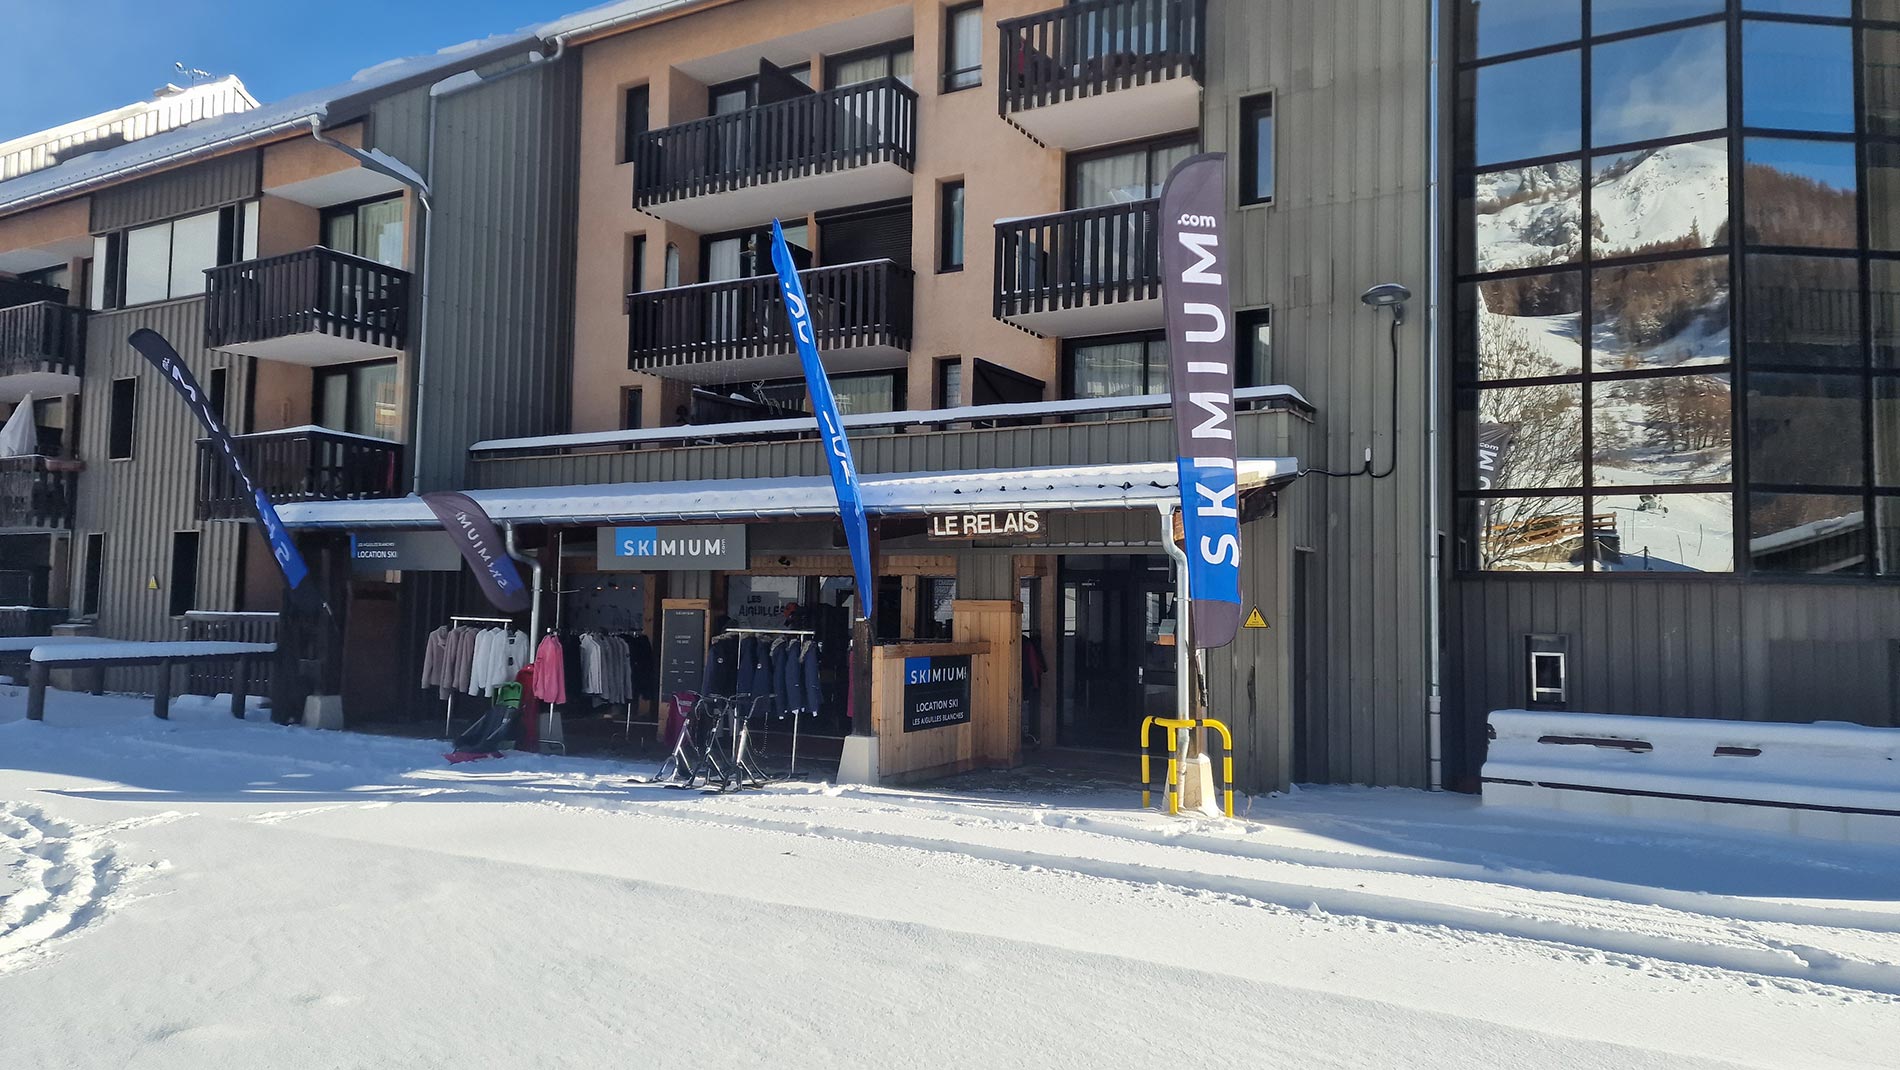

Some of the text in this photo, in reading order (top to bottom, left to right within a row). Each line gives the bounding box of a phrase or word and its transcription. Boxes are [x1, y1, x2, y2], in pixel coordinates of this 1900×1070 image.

[1177, 213, 1216, 228] .com
[1178, 231, 1240, 568] SKIMIUM
[933, 511, 1040, 536] LE RELAIS
[357, 550, 398, 558] LOCATION SKI
[623, 539, 721, 556] SKIMIUM
[910, 666, 964, 684] SKIMIUM
[916, 699, 959, 713] LOCATION SKI
[912, 718, 920, 726] LES
[942, 711, 964, 721] BLANCHES
